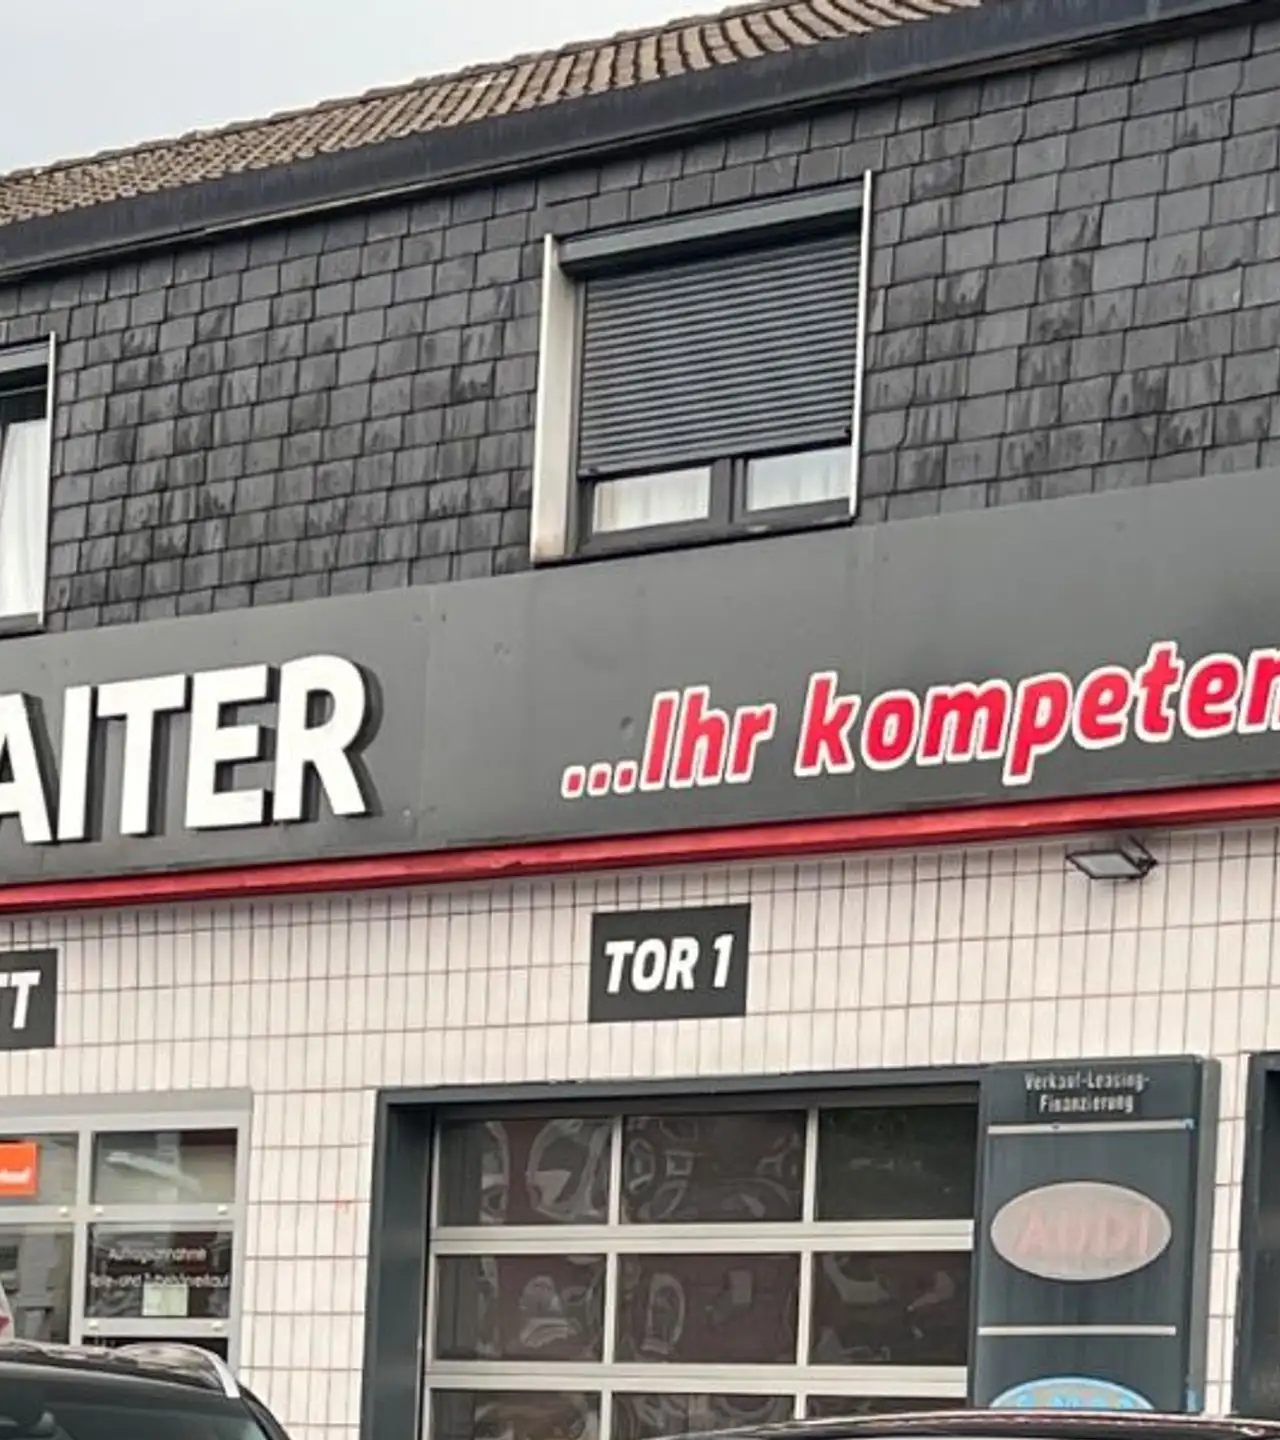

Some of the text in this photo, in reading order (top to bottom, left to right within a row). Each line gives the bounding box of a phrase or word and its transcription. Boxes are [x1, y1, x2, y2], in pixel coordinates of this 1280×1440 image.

[560, 688, 776, 799] ...Ihr
[603, 934, 734, 994] TOR 1
[1039, 1093, 1134, 1114] Finanzierung
